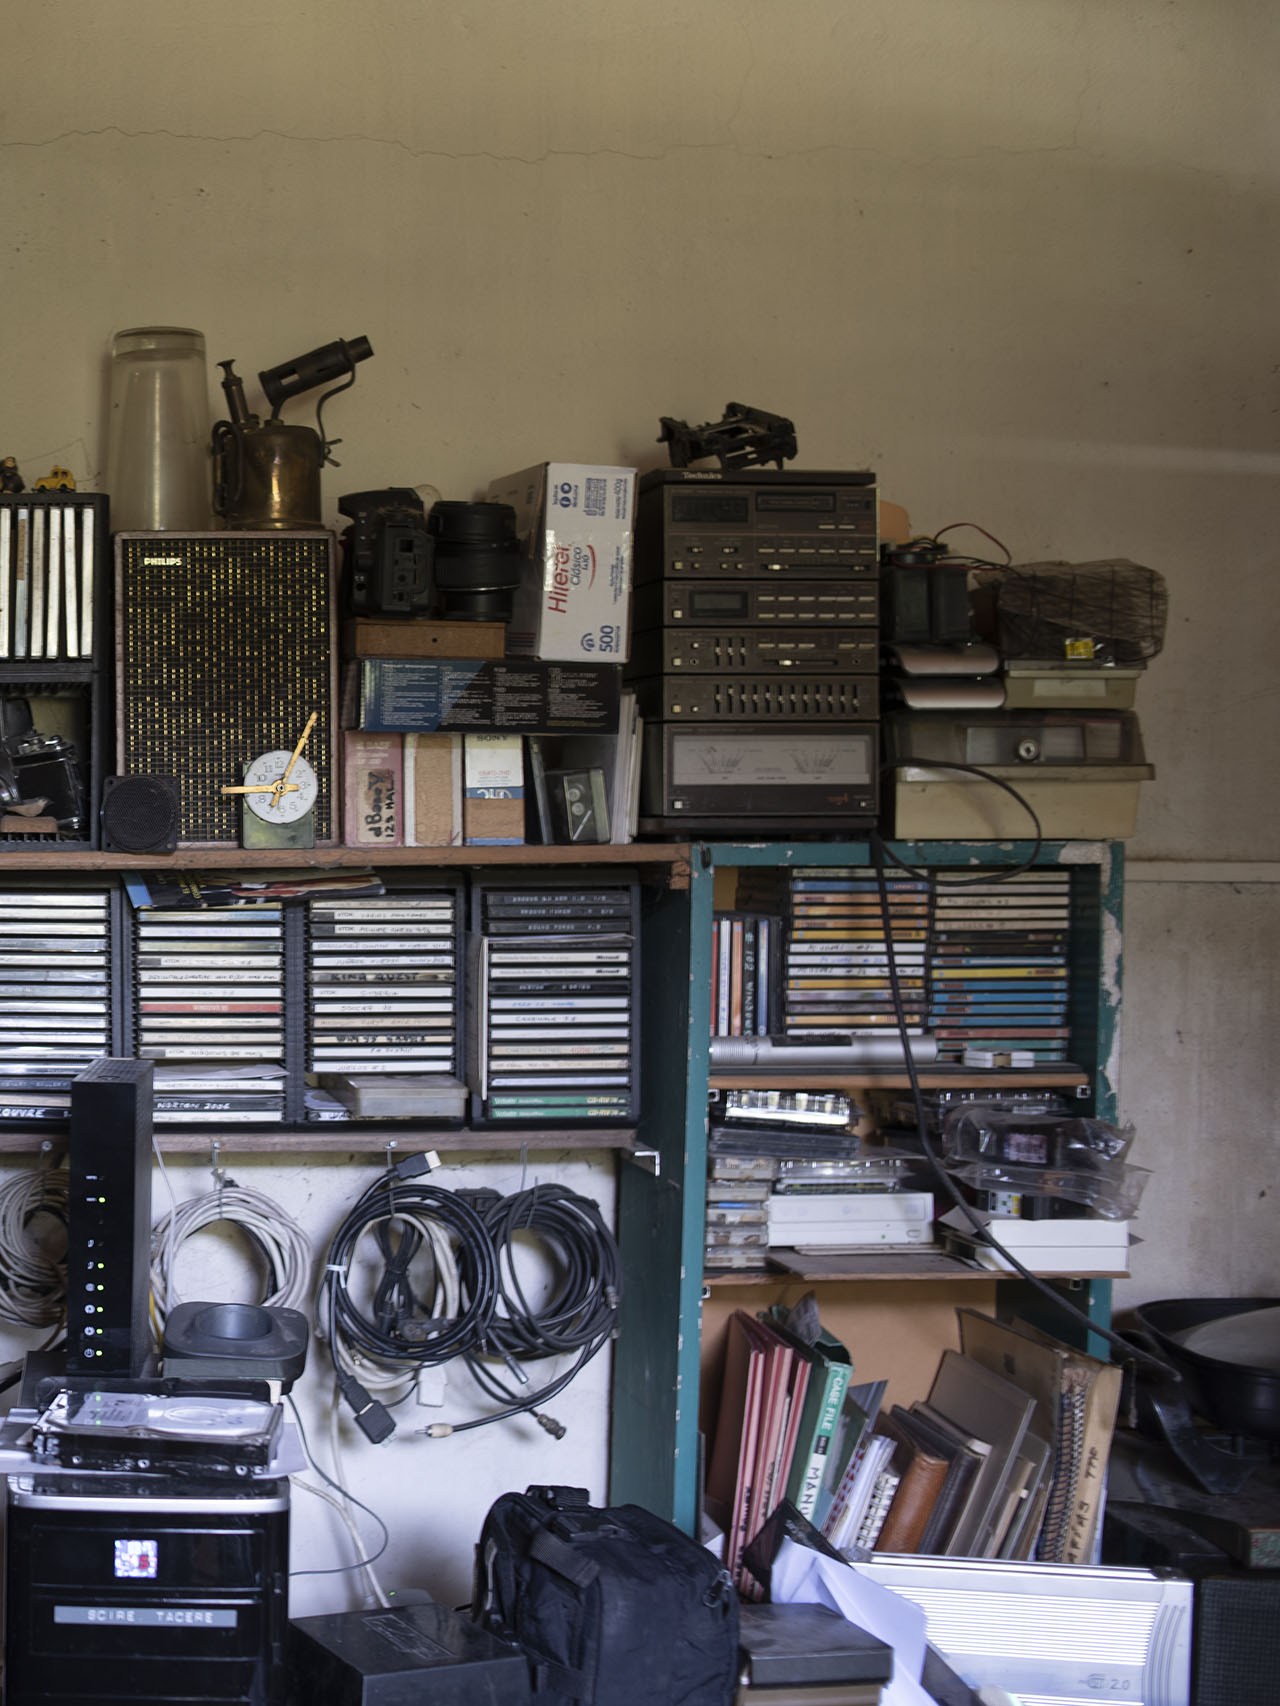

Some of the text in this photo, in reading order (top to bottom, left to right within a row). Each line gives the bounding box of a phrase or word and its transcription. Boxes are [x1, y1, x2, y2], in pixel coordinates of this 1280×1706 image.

[143, 557, 183, 567] PHILIPS
[570, 546, 582, 586] Clásico
[599, 625, 614, 653] 500
[821, 1407, 836, 1431] FILE
[87, 1610, 214, 1624] SCIRE TACERE
